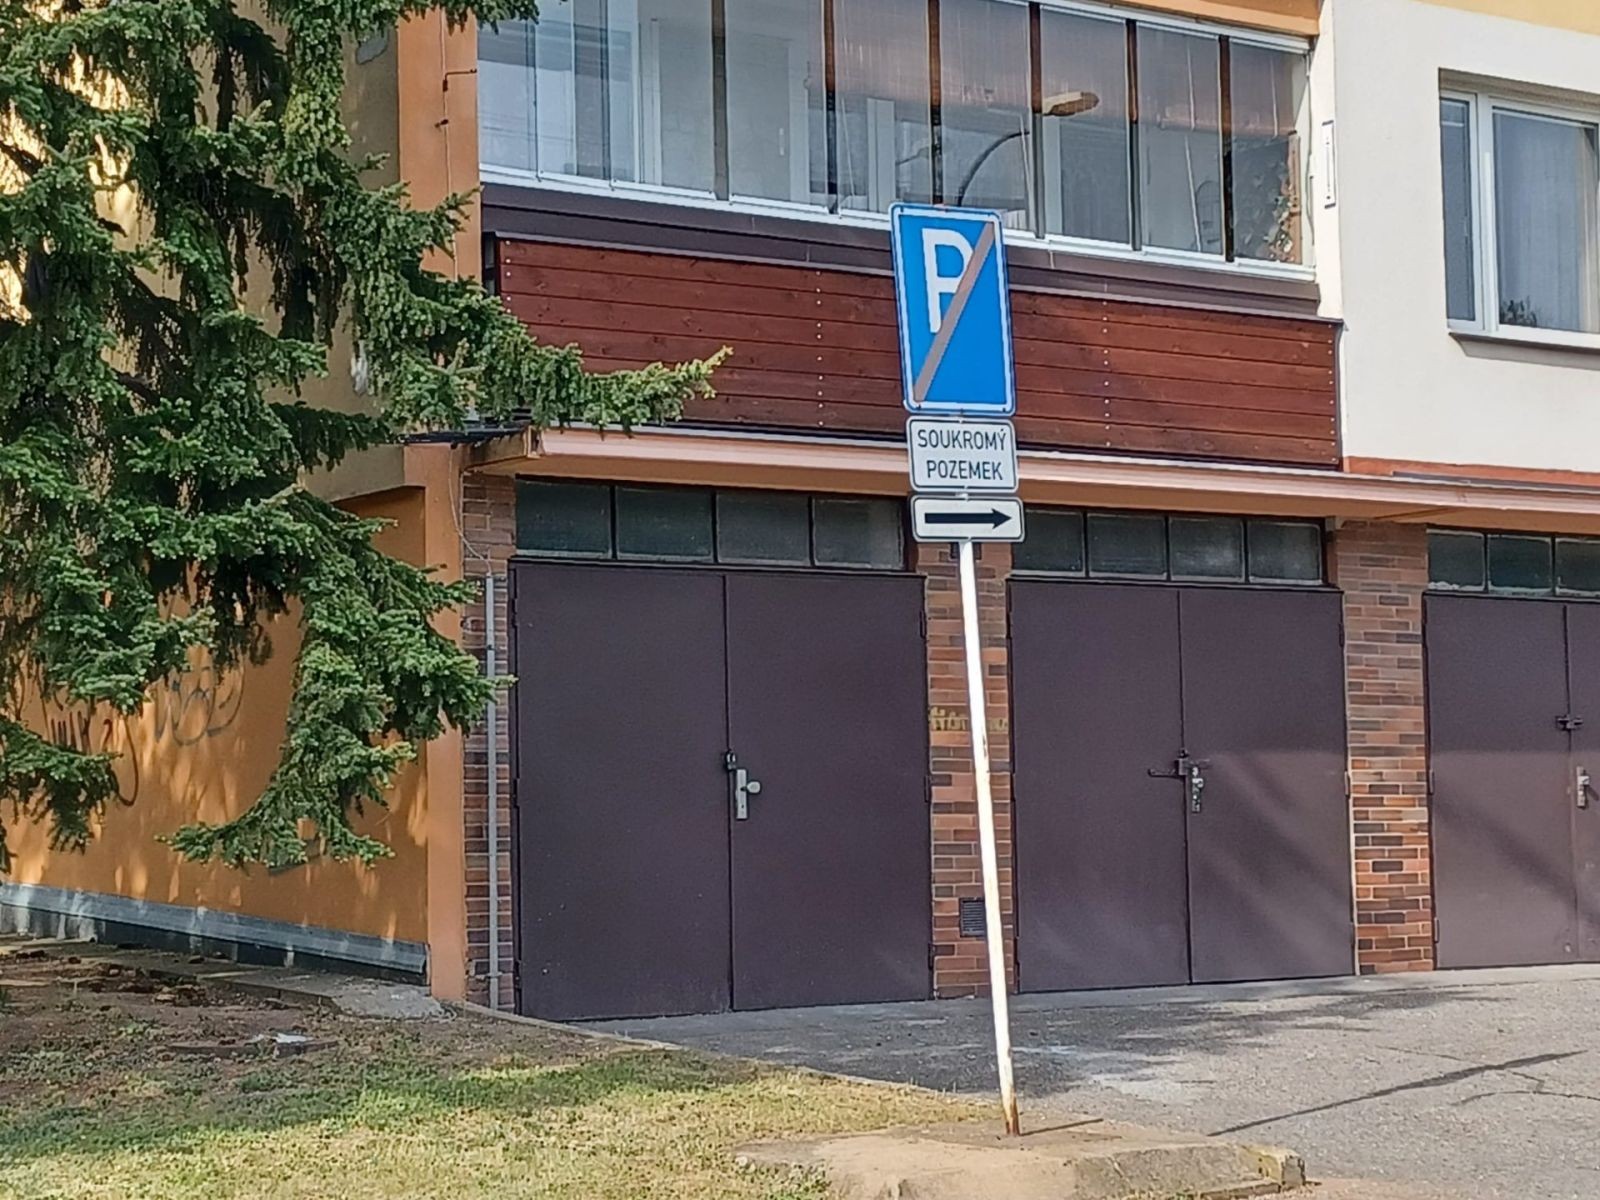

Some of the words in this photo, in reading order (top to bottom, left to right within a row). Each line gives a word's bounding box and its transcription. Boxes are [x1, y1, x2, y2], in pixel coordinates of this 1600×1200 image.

[922, 227, 974, 333] P
[917, 428, 1007, 451] SOUKROMÝ
[926, 460, 1004, 481] POZEMEK
